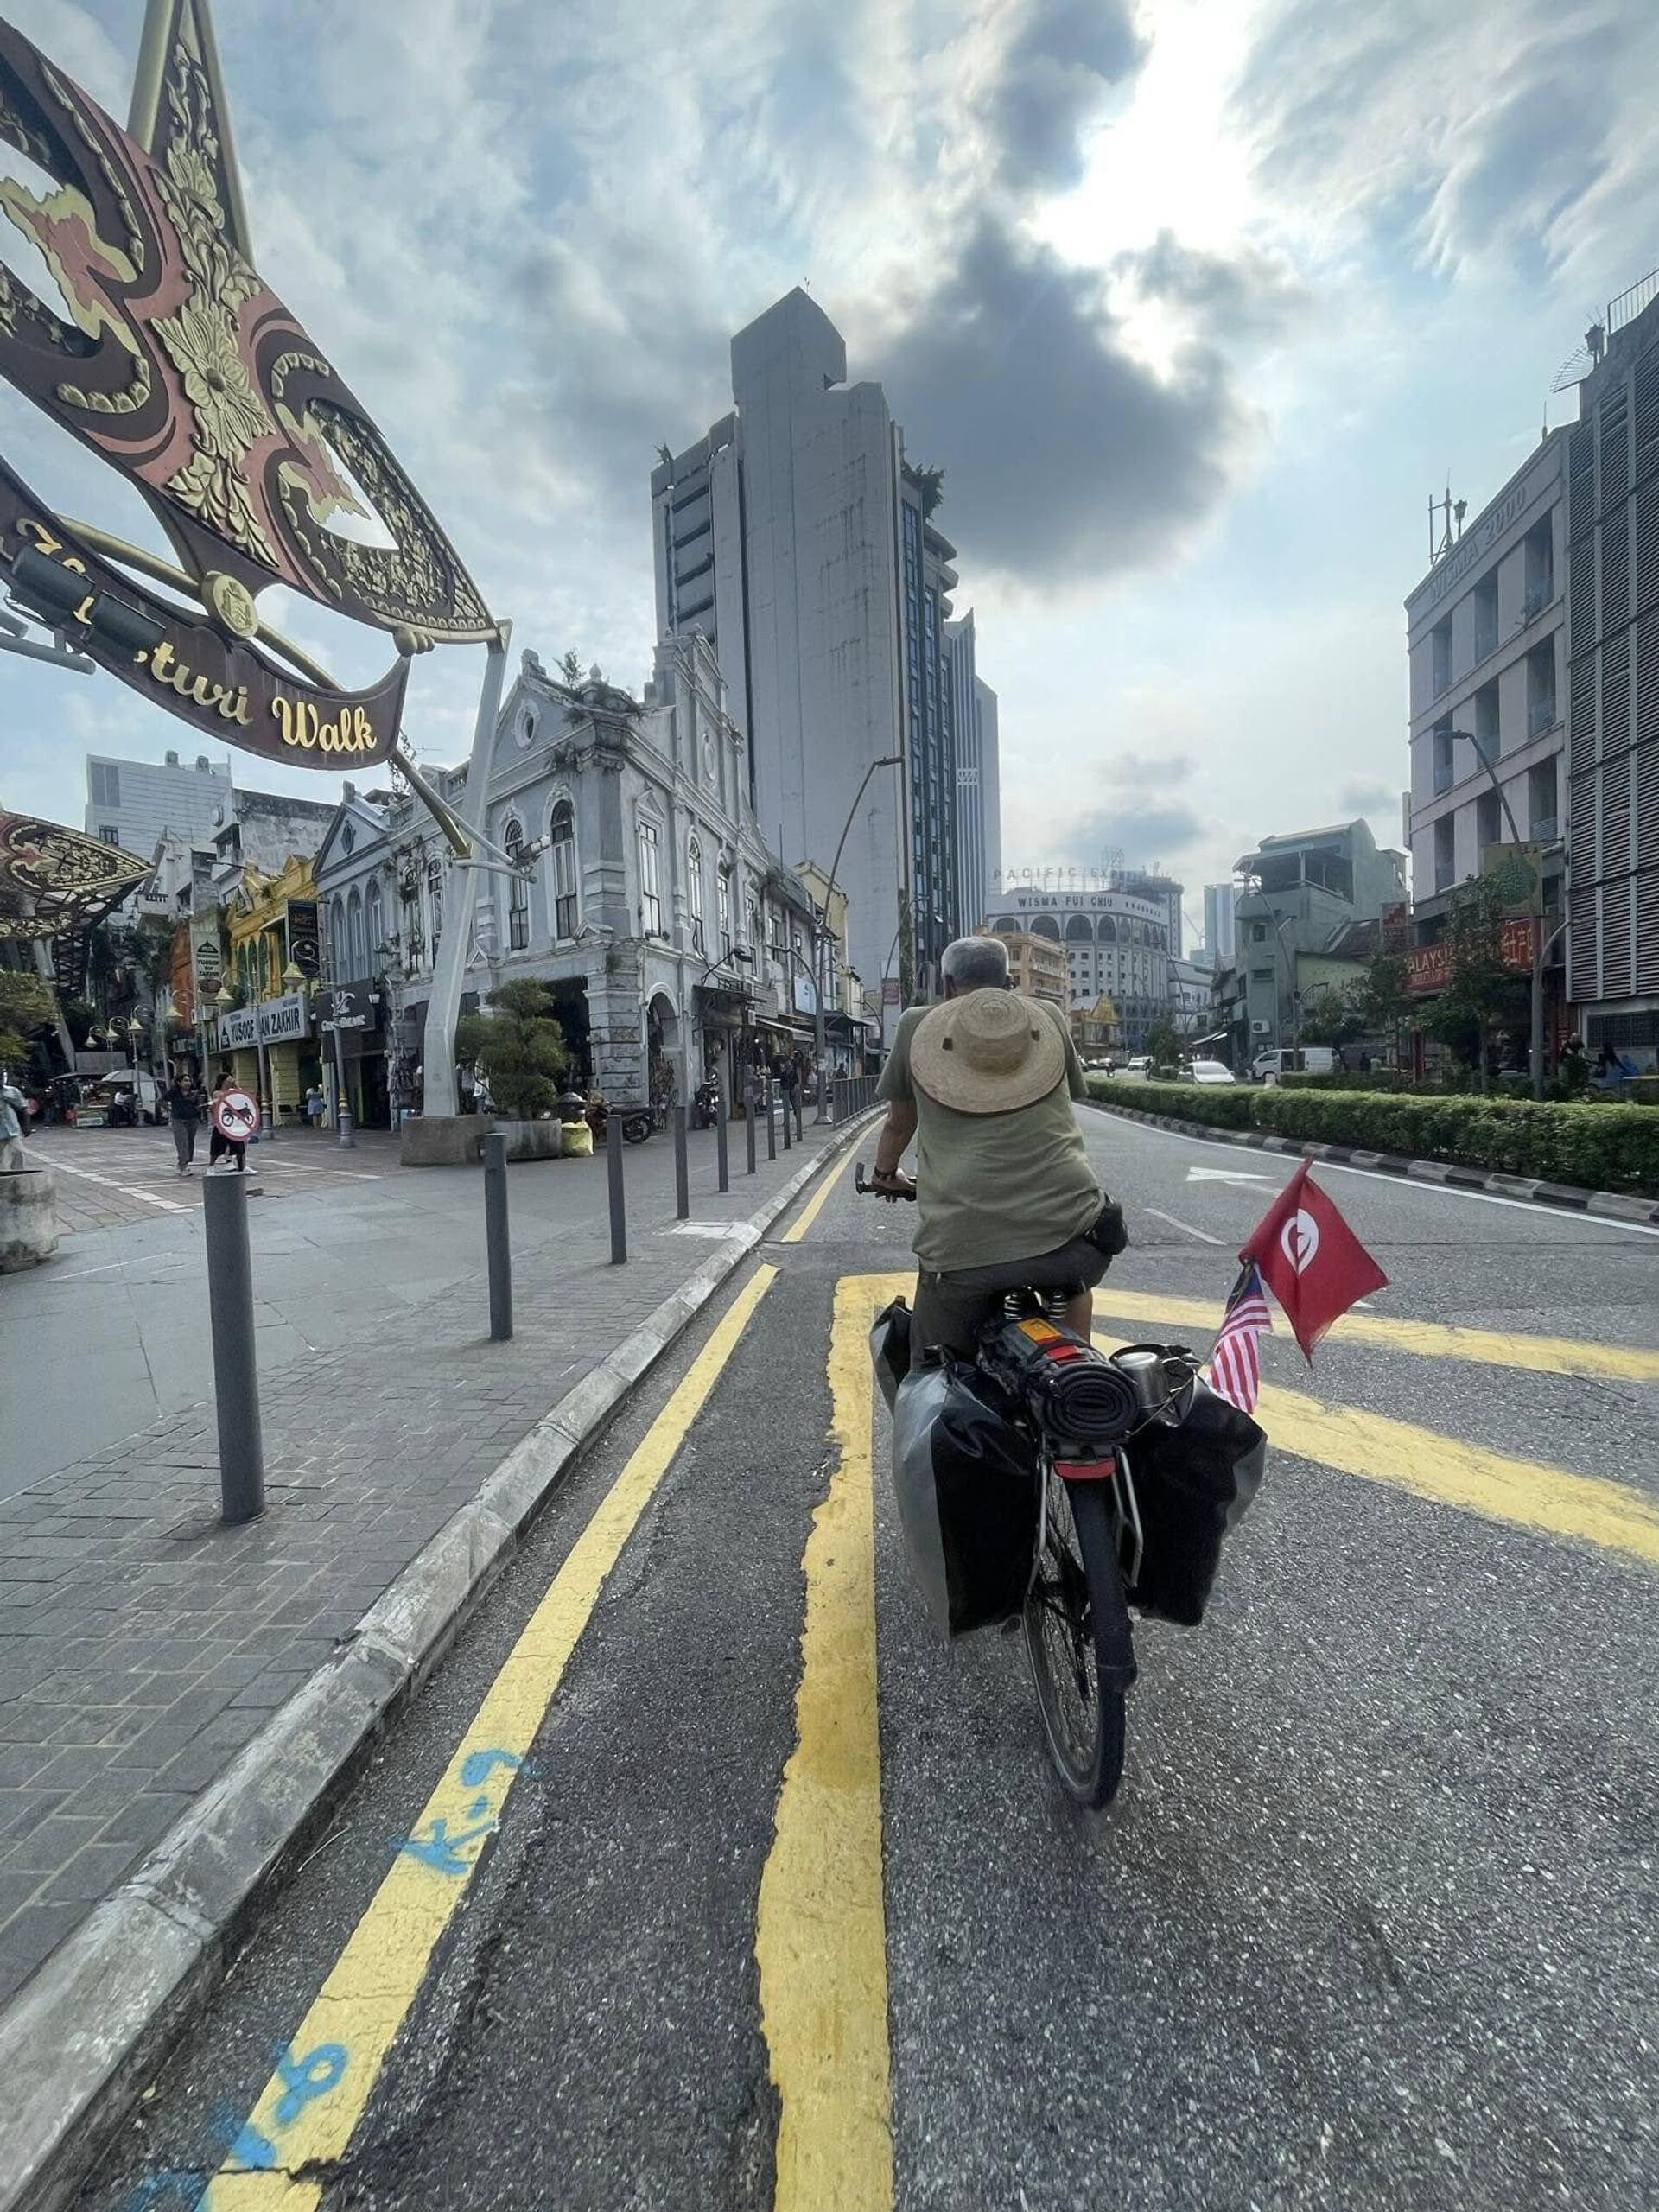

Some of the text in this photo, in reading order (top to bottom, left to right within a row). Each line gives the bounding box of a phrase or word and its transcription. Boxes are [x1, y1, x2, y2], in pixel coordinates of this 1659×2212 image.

[1485, 486, 1526, 545] 2000
[272, 696, 378, 752] Walk
[995, 867, 1077, 880] PACIFIC
[1018, 897, 1058, 907] WISMA
[231, 1020, 254, 1042] YUSOOF
[271, 1007, 301, 1034] ZAKHIR
